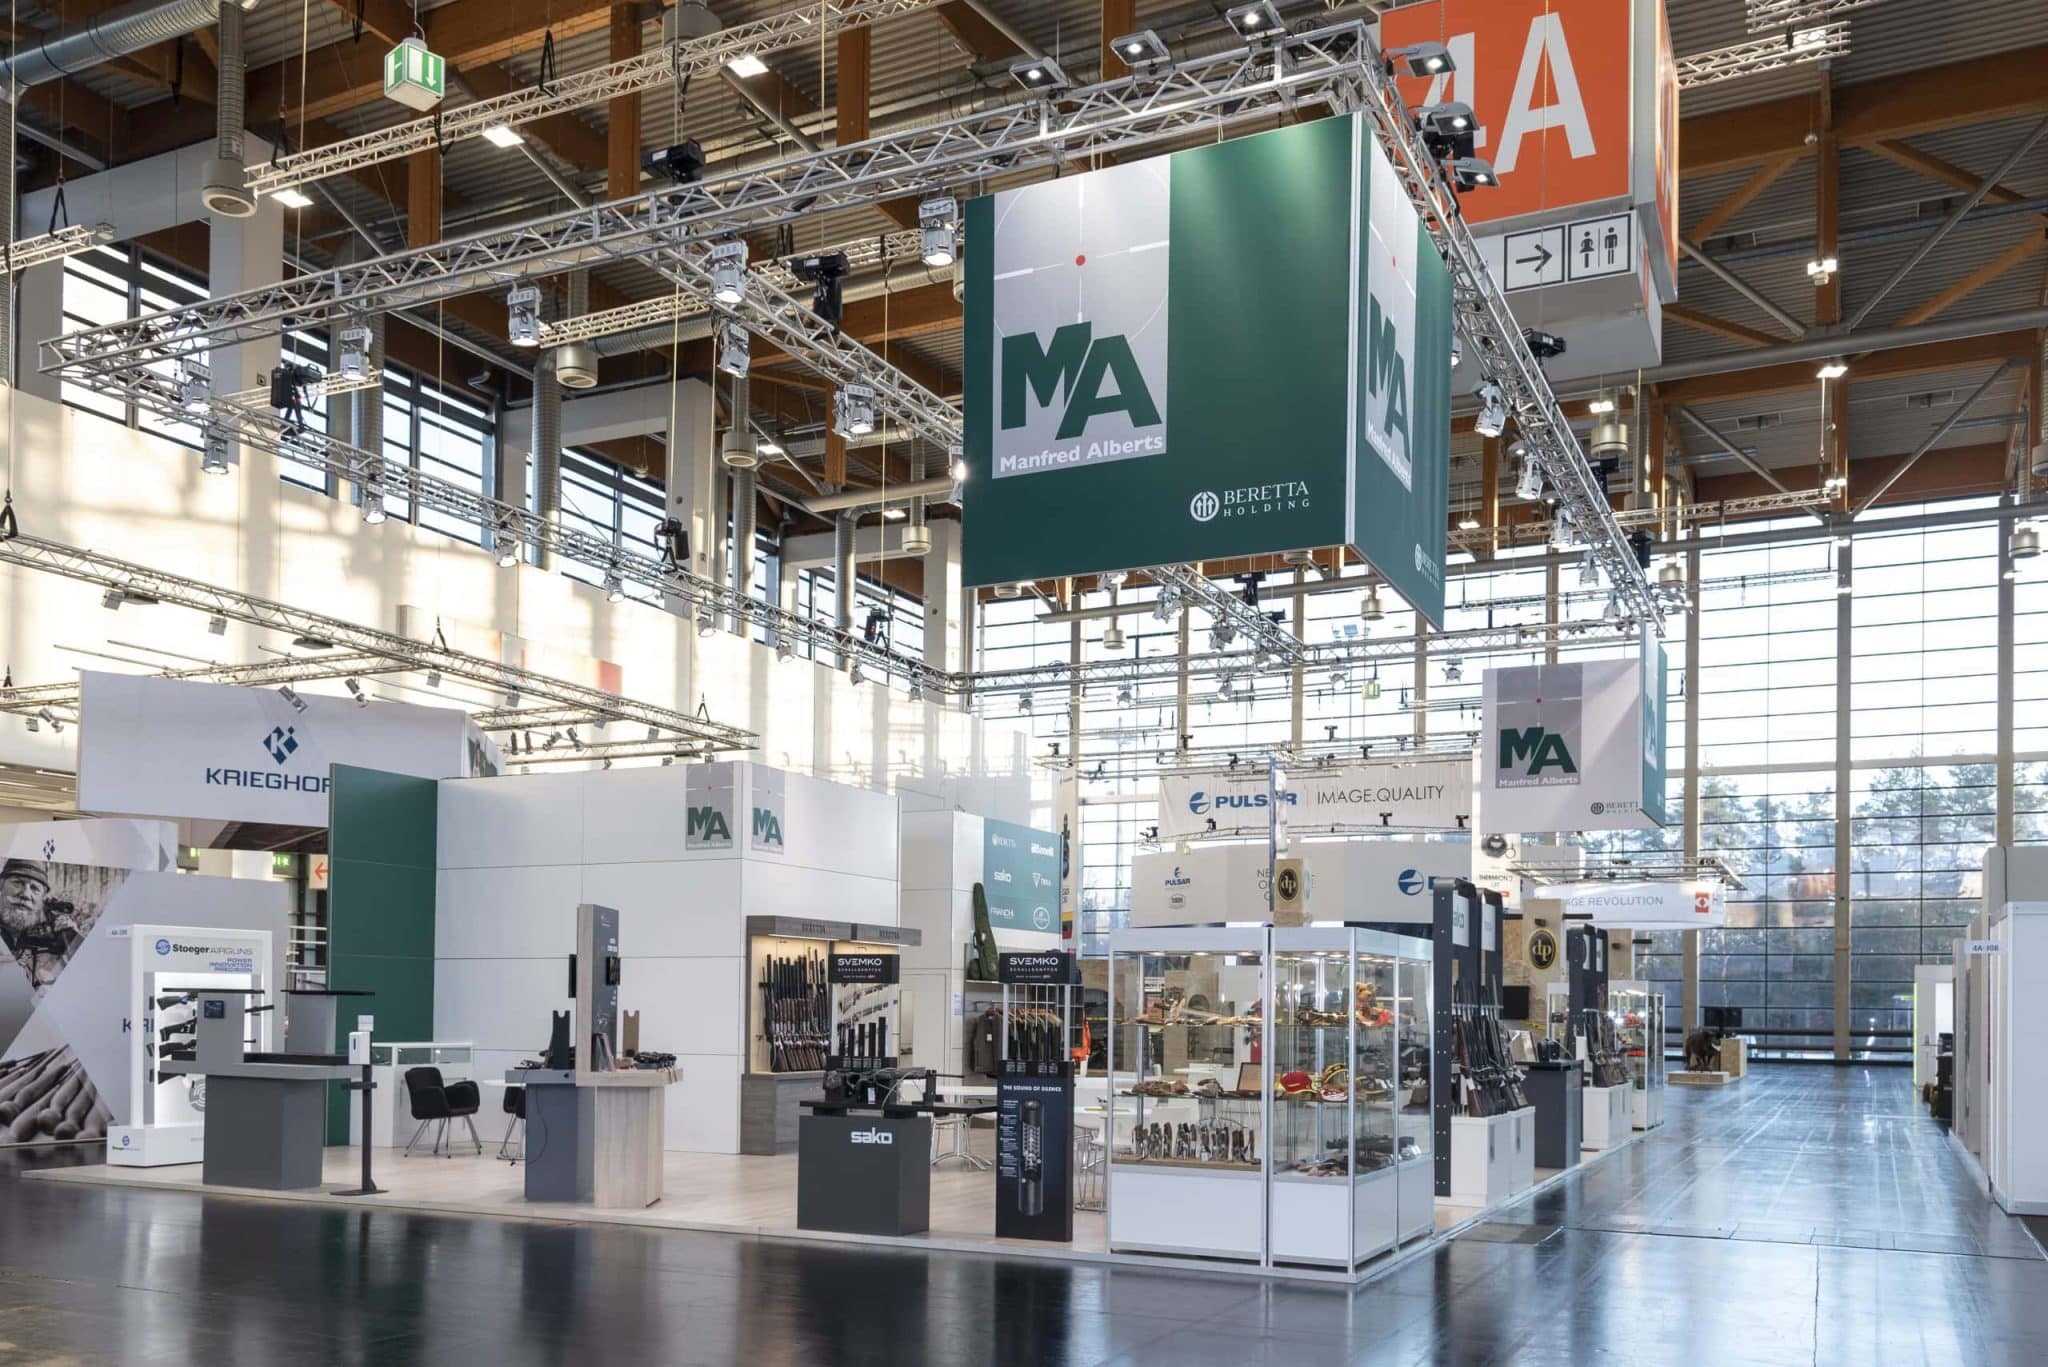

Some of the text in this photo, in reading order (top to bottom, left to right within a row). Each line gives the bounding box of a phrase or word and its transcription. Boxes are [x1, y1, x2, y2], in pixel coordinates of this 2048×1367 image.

[1001, 321, 1162, 440] MA
[1369, 293, 1411, 464] MA
[1000, 433, 1163, 473] Manfred Alberts
[1223, 481, 1310, 505] BERETTA
[1223, 499, 1310, 517] HOLDING
[1500, 727, 1577, 775] MA
[1499, 775, 1578, 787] Manfred Alberts
[1317, 785, 1445, 804] IMAGE.QUALITY
[688, 806, 732, 841] MA
[752, 807, 783, 846] MA
[1165, 878, 1191, 887] PULSAR
[1588, 895, 1664, 907] REVOLUTION
[172, 943, 211, 955] Stoeger
[837, 957, 882, 967] SVEMKO
[1009, 957, 1059, 966] SVEMKO
[850, 1127, 893, 1145] sako
